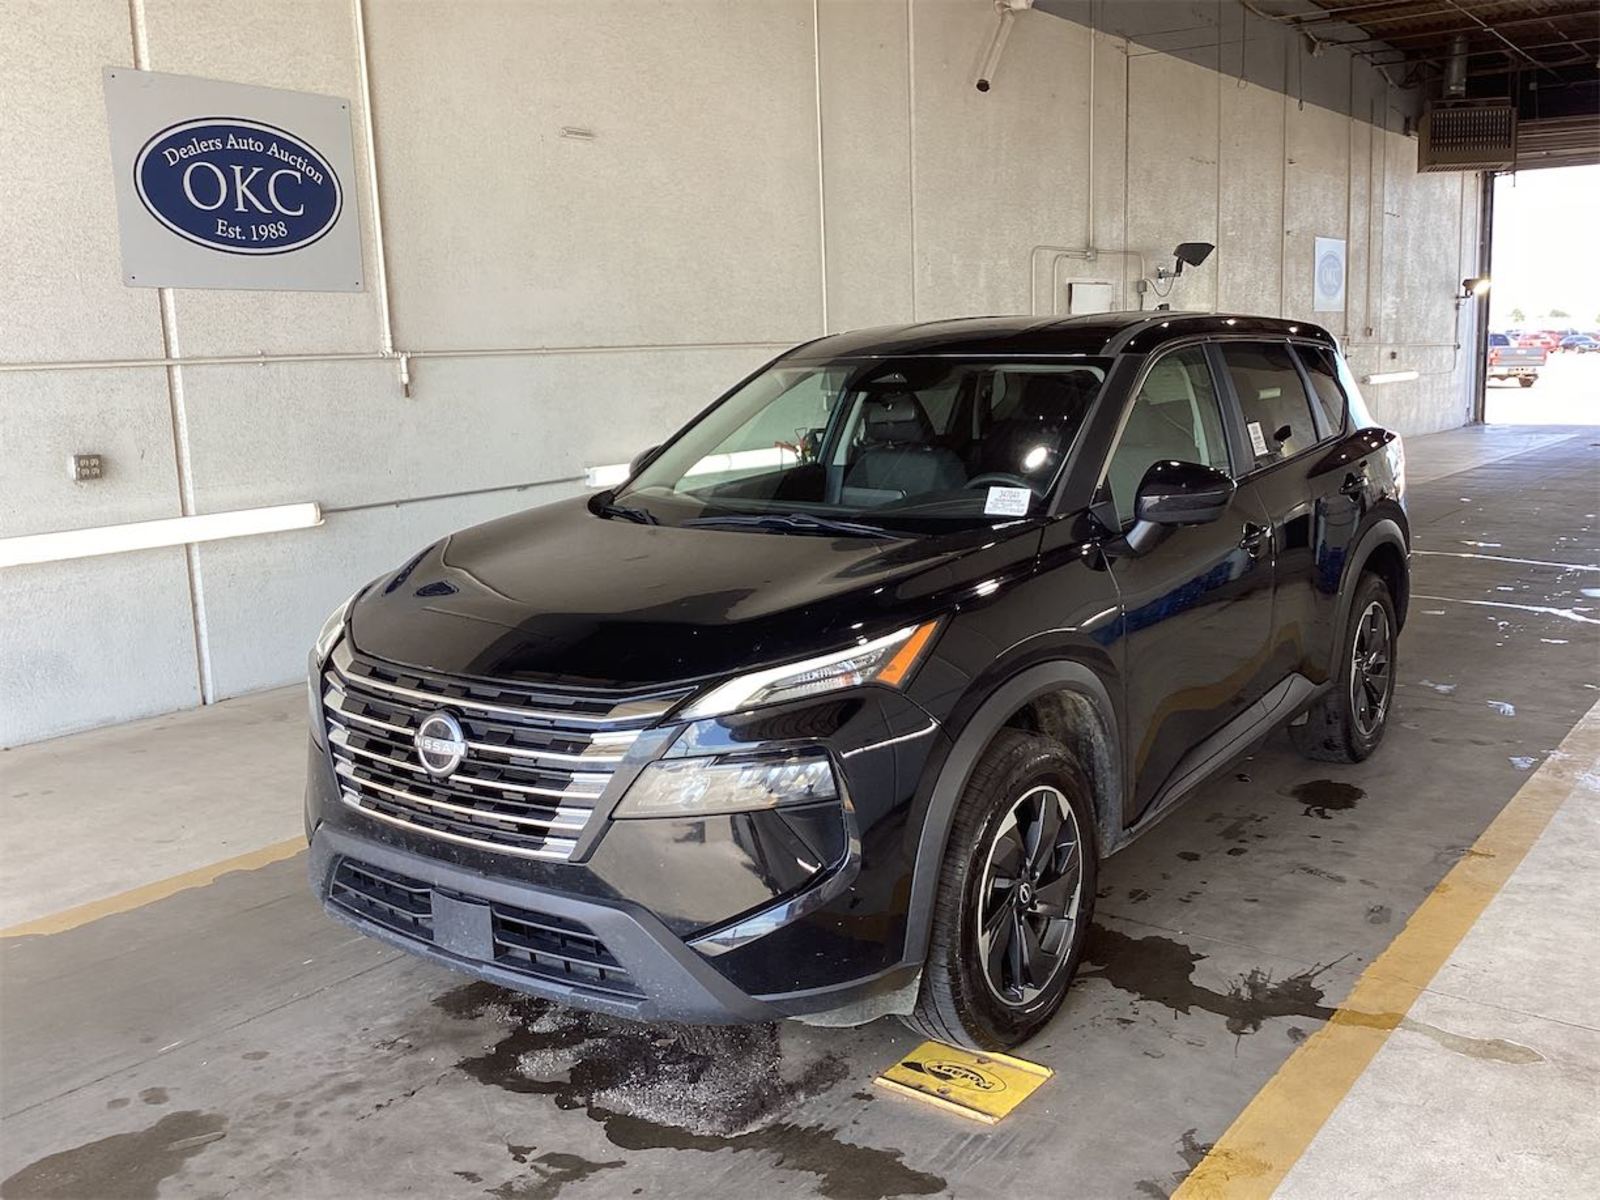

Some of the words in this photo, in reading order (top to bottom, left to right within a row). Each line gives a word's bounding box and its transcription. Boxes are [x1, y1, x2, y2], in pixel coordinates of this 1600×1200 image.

[162, 137, 223, 167] Dealers
[226, 133, 264, 153] Auto
[266, 142, 324, 186] Auction
[182, 161, 304, 217] OKC
[215, 218, 246, 241] Est.
[251, 220, 288, 241] 1988
[415, 734, 466, 756] NISSAN
